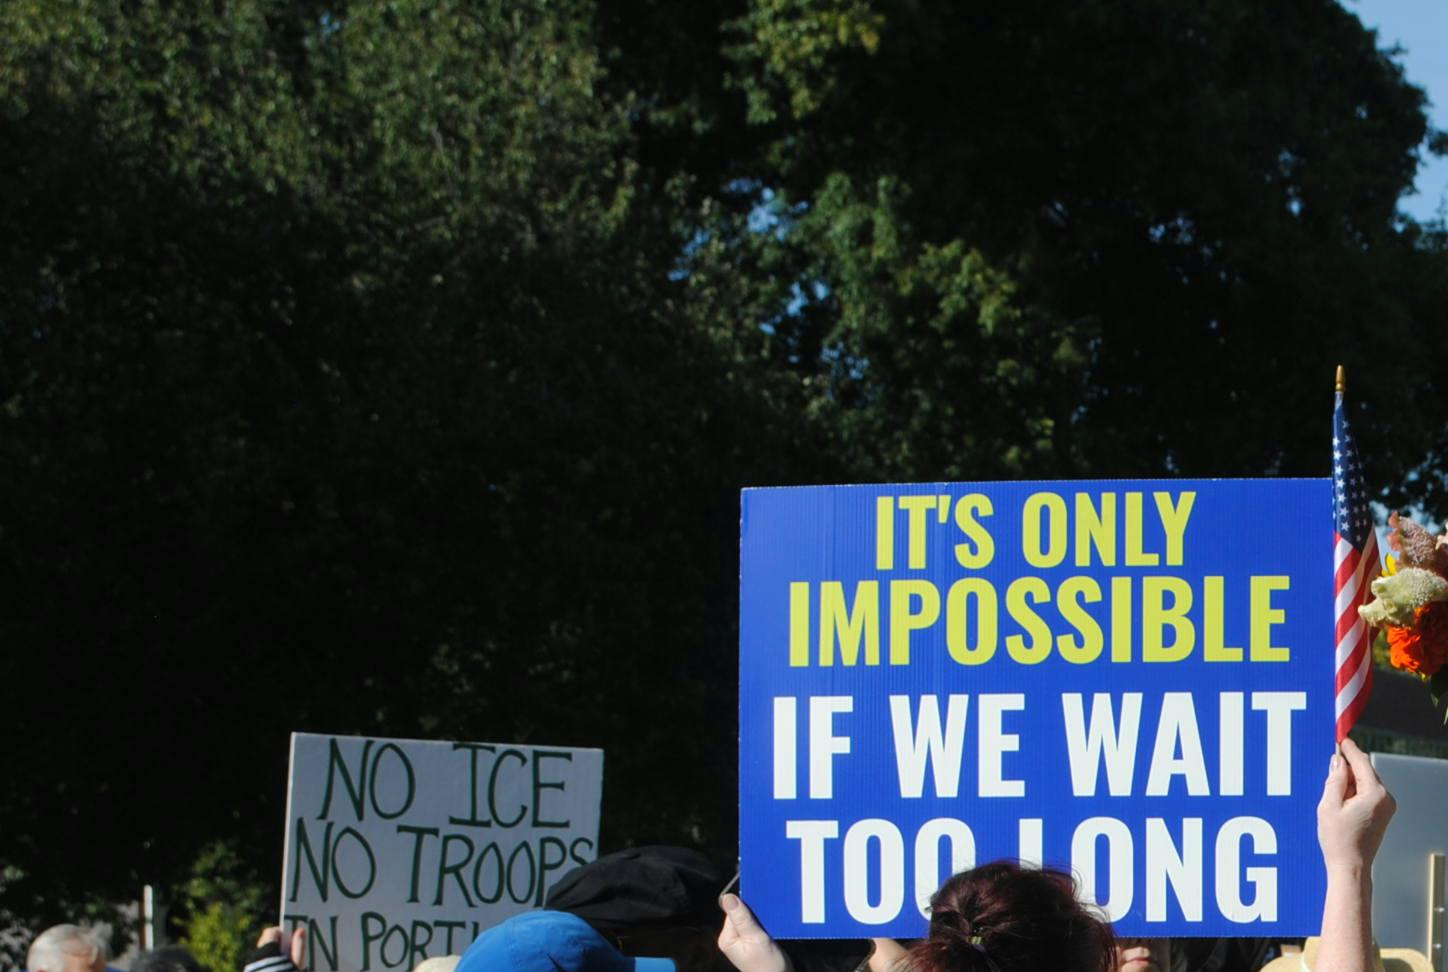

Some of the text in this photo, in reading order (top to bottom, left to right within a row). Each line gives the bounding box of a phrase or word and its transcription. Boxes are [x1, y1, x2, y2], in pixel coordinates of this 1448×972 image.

[875, 490, 1197, 571] IT'S ONLY
[789, 575, 1290, 668] IMPOSSIBLE
[316, 738, 573, 828] NO ICE
[772, 691, 1307, 800] IF WE WAIT
[289, 817, 377, 903] NO
[786, 818, 977, 925] TOO
